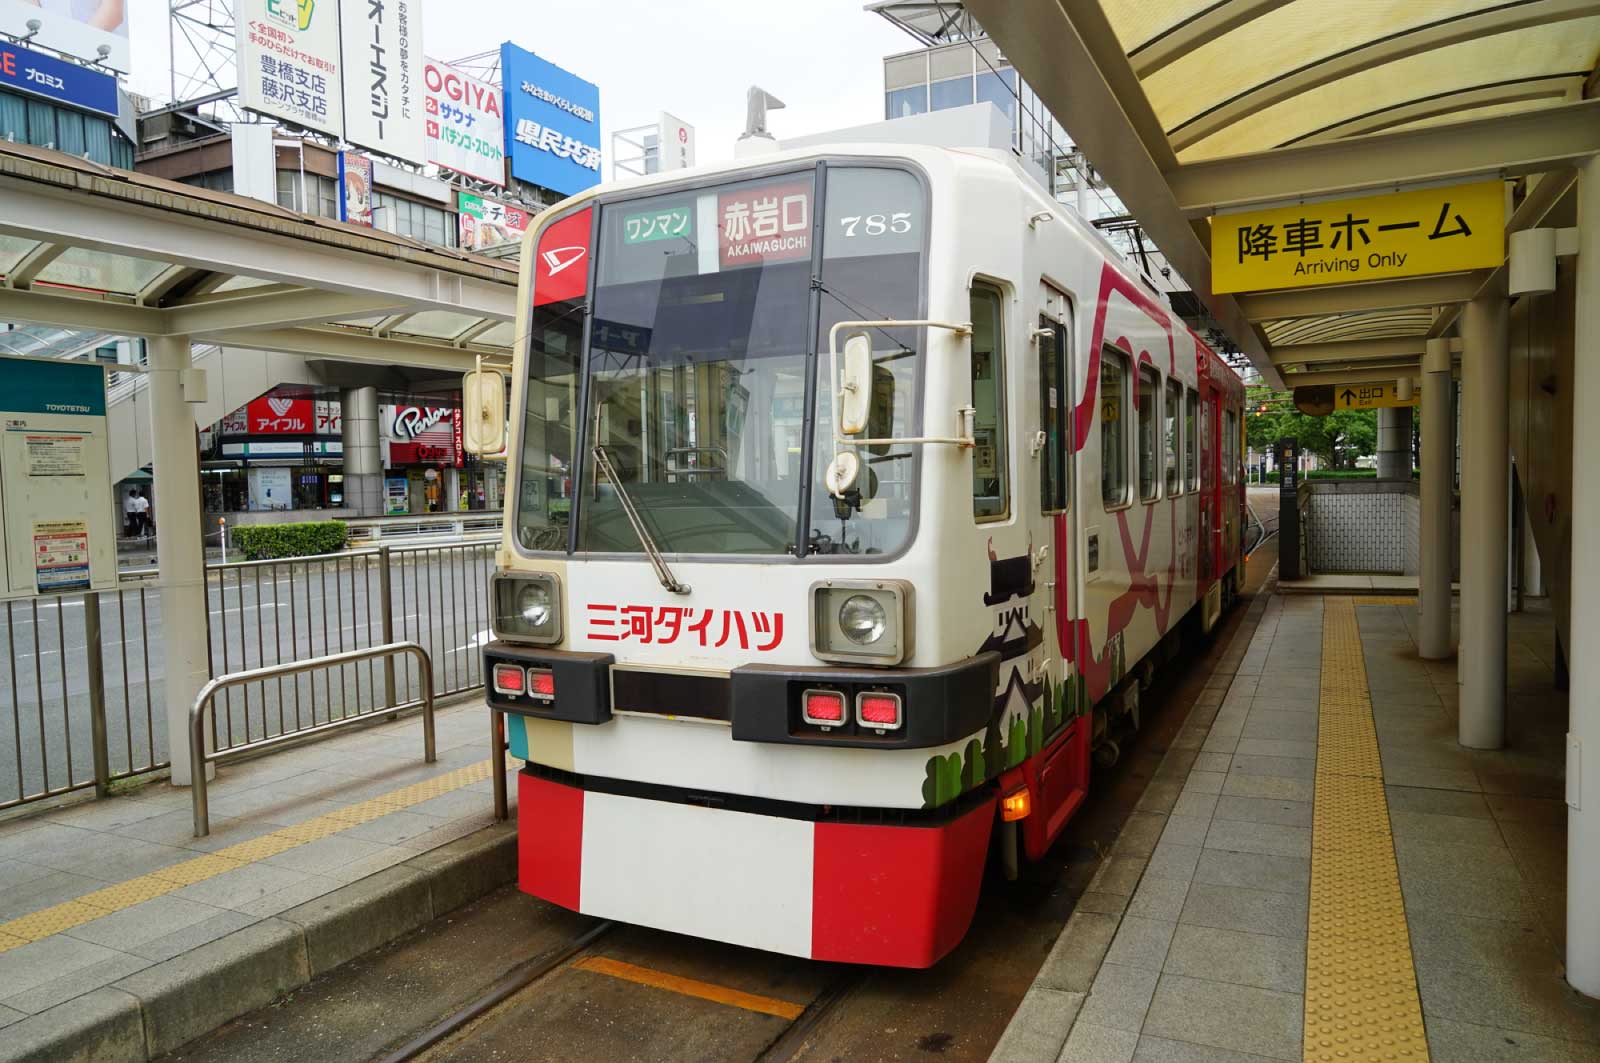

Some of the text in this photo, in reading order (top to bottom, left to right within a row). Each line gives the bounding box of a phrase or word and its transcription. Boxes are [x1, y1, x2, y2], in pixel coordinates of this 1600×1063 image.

[0, 50, 17, 77] E
[261, 54, 326, 95] 豊橋支店
[24, 68, 65, 91] プロミス
[424, 64, 501, 119] OGIYA
[261, 76, 328, 116] 藤沢支店
[440, 101, 476, 128] サウナ
[441, 125, 503, 161] パチンコ・スロット
[514, 118, 602, 173] 県民共済
[626, 194, 808, 241] ワンマン 赤岩口
[839, 211, 913, 238] 785
[727, 235, 808, 258] AKAIWAGUCHI
[1237, 202, 1474, 265] 降車ホーム
[1293, 251, 1408, 276] Arriving Only
[1359, 386, 1384, 399] 出口
[45, 403, 91, 413] TOYOTETSU
[222, 420, 247, 433] アイフル
[256, 417, 306, 432] アイフル
[586, 603, 785, 652] 三河ダイハツ
